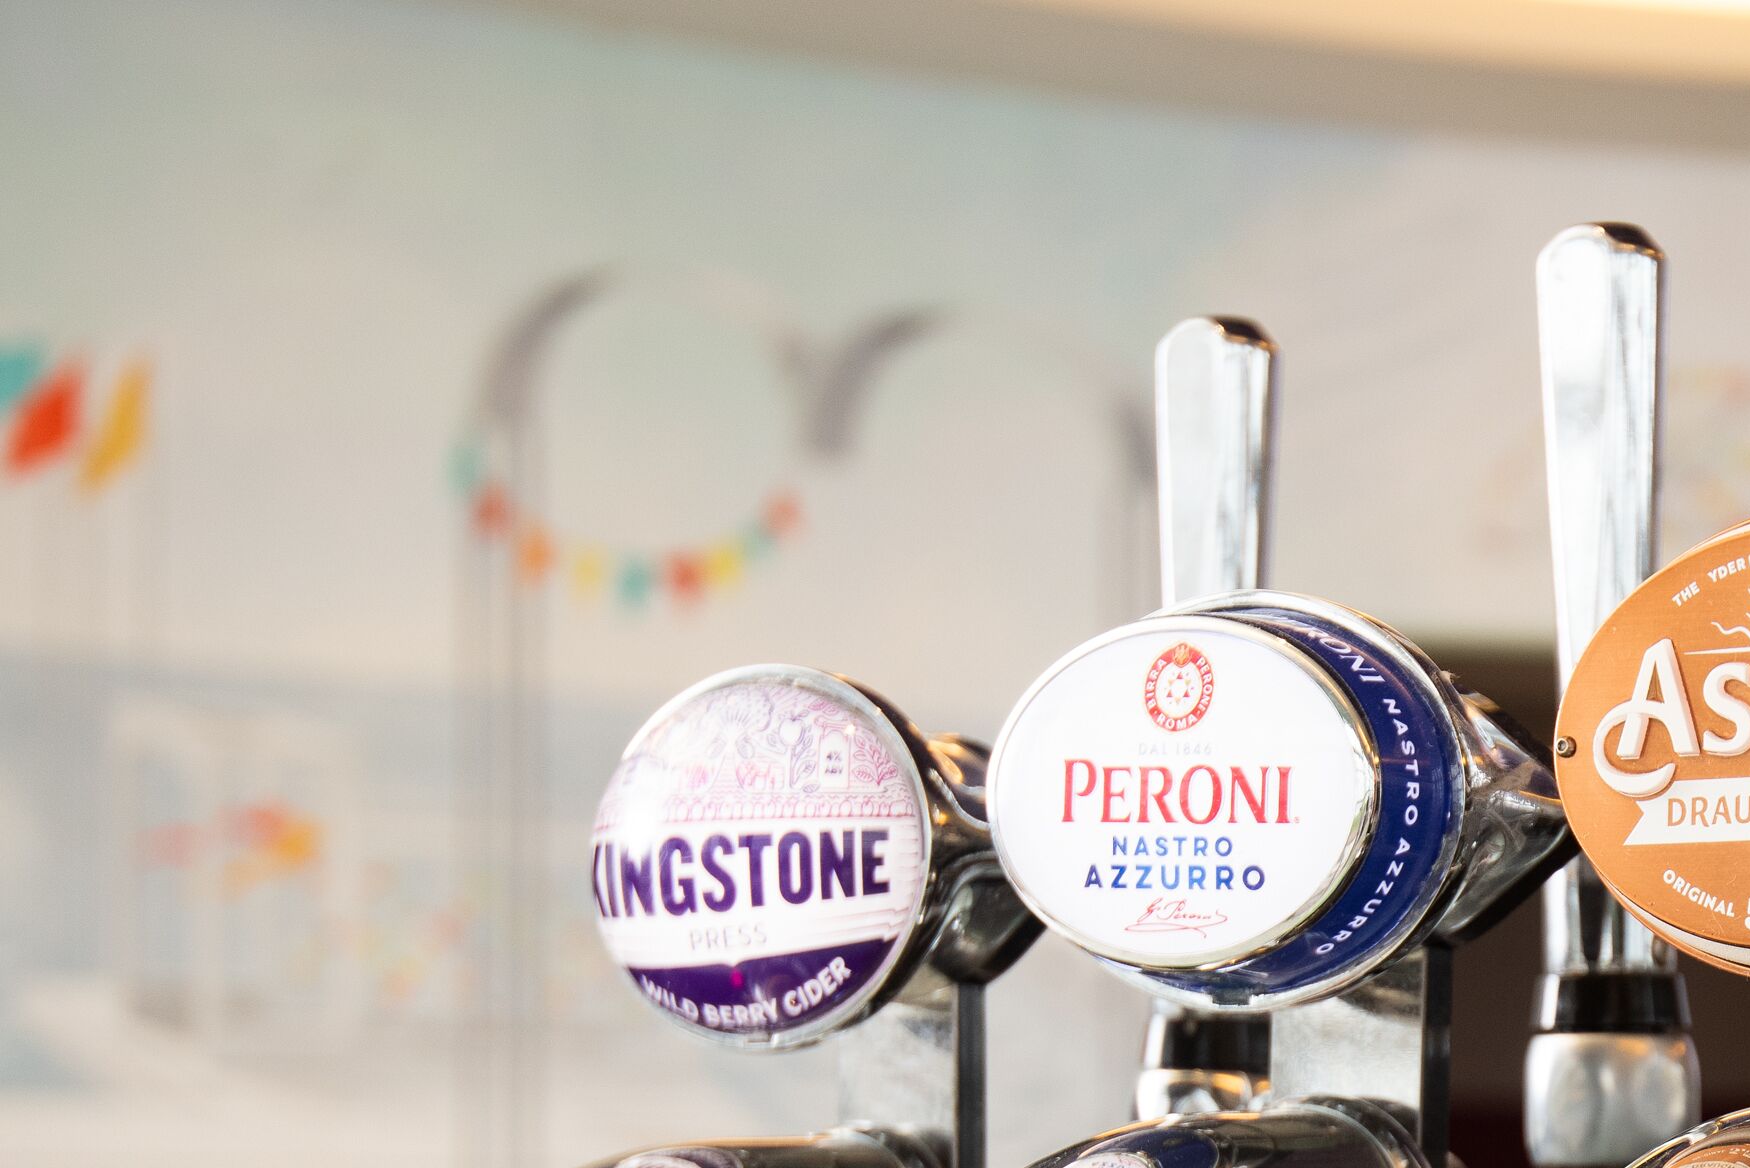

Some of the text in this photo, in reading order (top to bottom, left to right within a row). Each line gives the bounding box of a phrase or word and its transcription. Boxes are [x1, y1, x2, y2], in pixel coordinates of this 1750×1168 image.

[1672, 581, 1700, 607] THE
[1706, 557, 1746, 583] YDER
[1156, 713, 1198, 730] ROMA
[1383, 698, 1421, 826] NASTRO
[1061, 759, 1292, 825] PERONI
[1112, 836, 1233, 857] NASTRO
[1084, 863, 1266, 891] AZZURRO
[1314, 837, 1411, 955] AZZURRO
[1662, 869, 1735, 918] ORIGINAL
[689, 922, 767, 950] PRESS
[640, 956, 852, 1028] WILD BERRY CIDER
